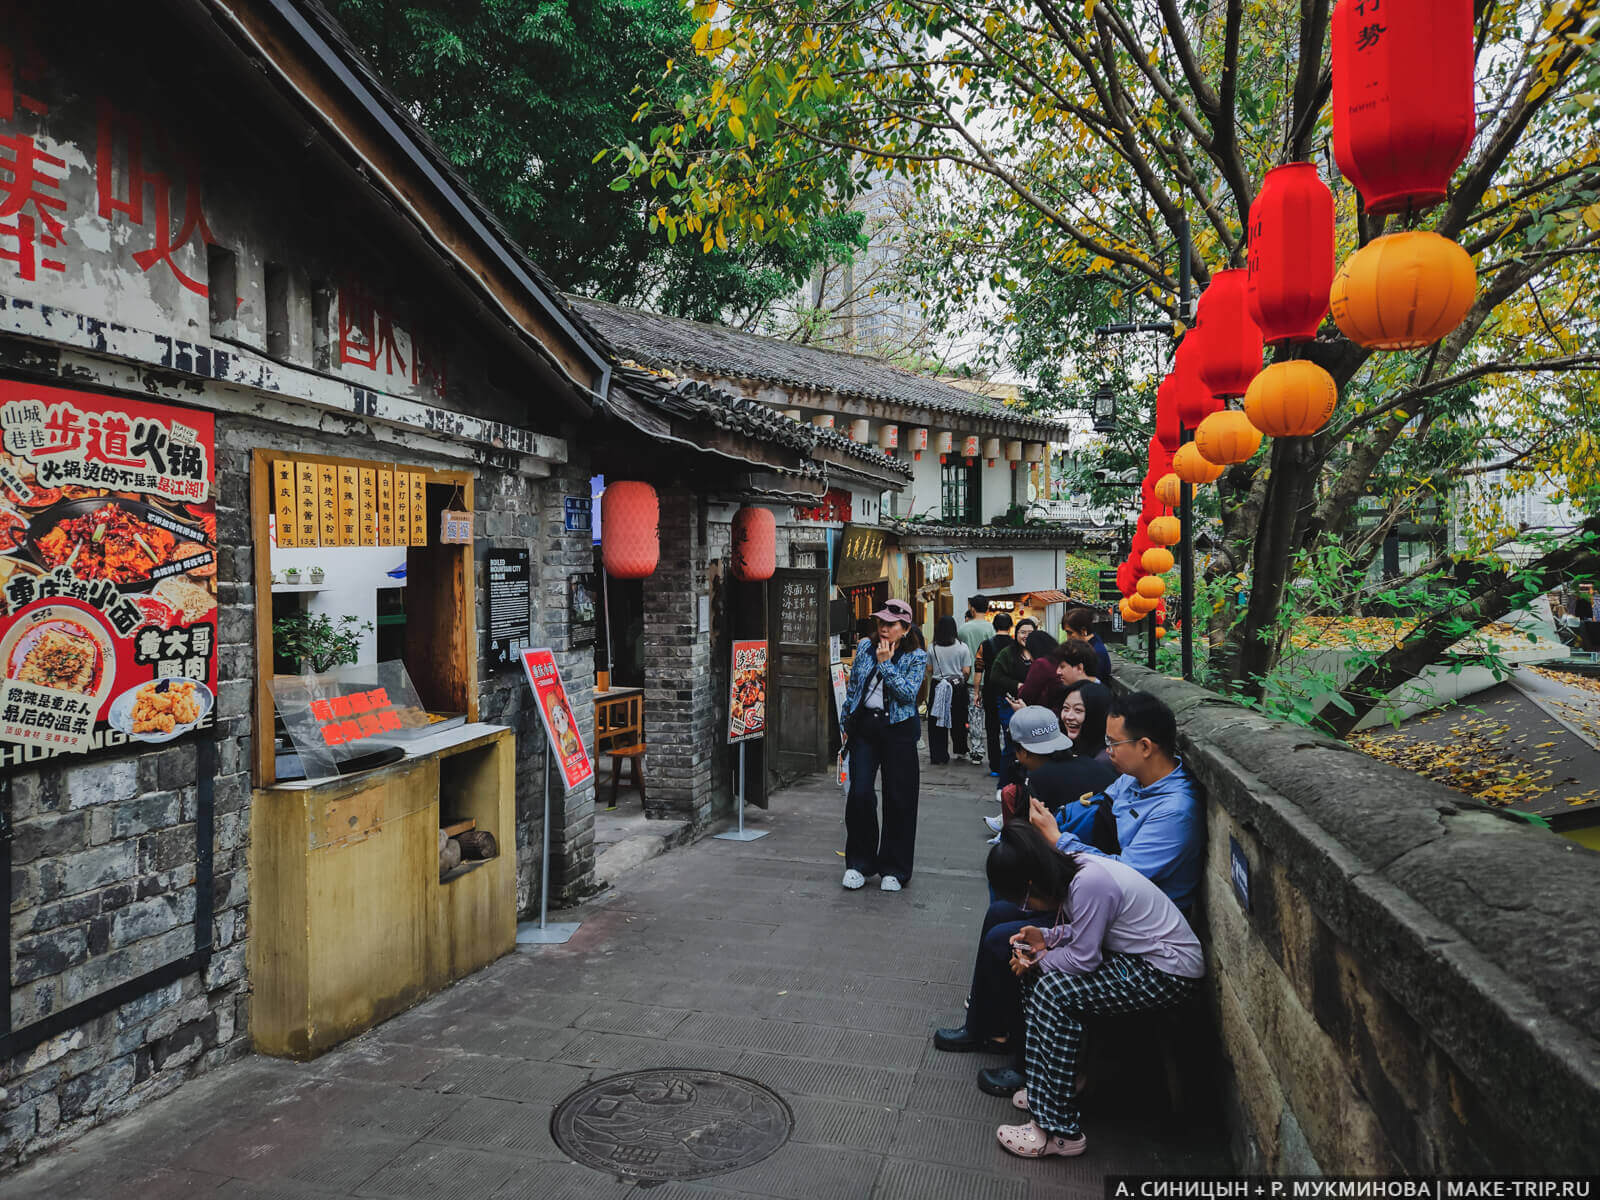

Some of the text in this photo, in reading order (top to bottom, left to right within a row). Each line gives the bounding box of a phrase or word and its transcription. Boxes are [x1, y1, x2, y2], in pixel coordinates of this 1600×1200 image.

[5, 405, 42, 424] 山城
[8, 426, 45, 449] 巷巷
[31, 407, 201, 480] 步道火锅
[280, 470, 291, 534] 重庆小面
[512, 565, 521, 573] CITY
[139, 627, 210, 660] 黄大哥
[157, 656, 206, 681] 酥肉
[8, 688, 91, 716] 微辣是重庆人
[2, 704, 88, 735] 最后的温柔
[5, 725, 41, 739] 顶级食材
